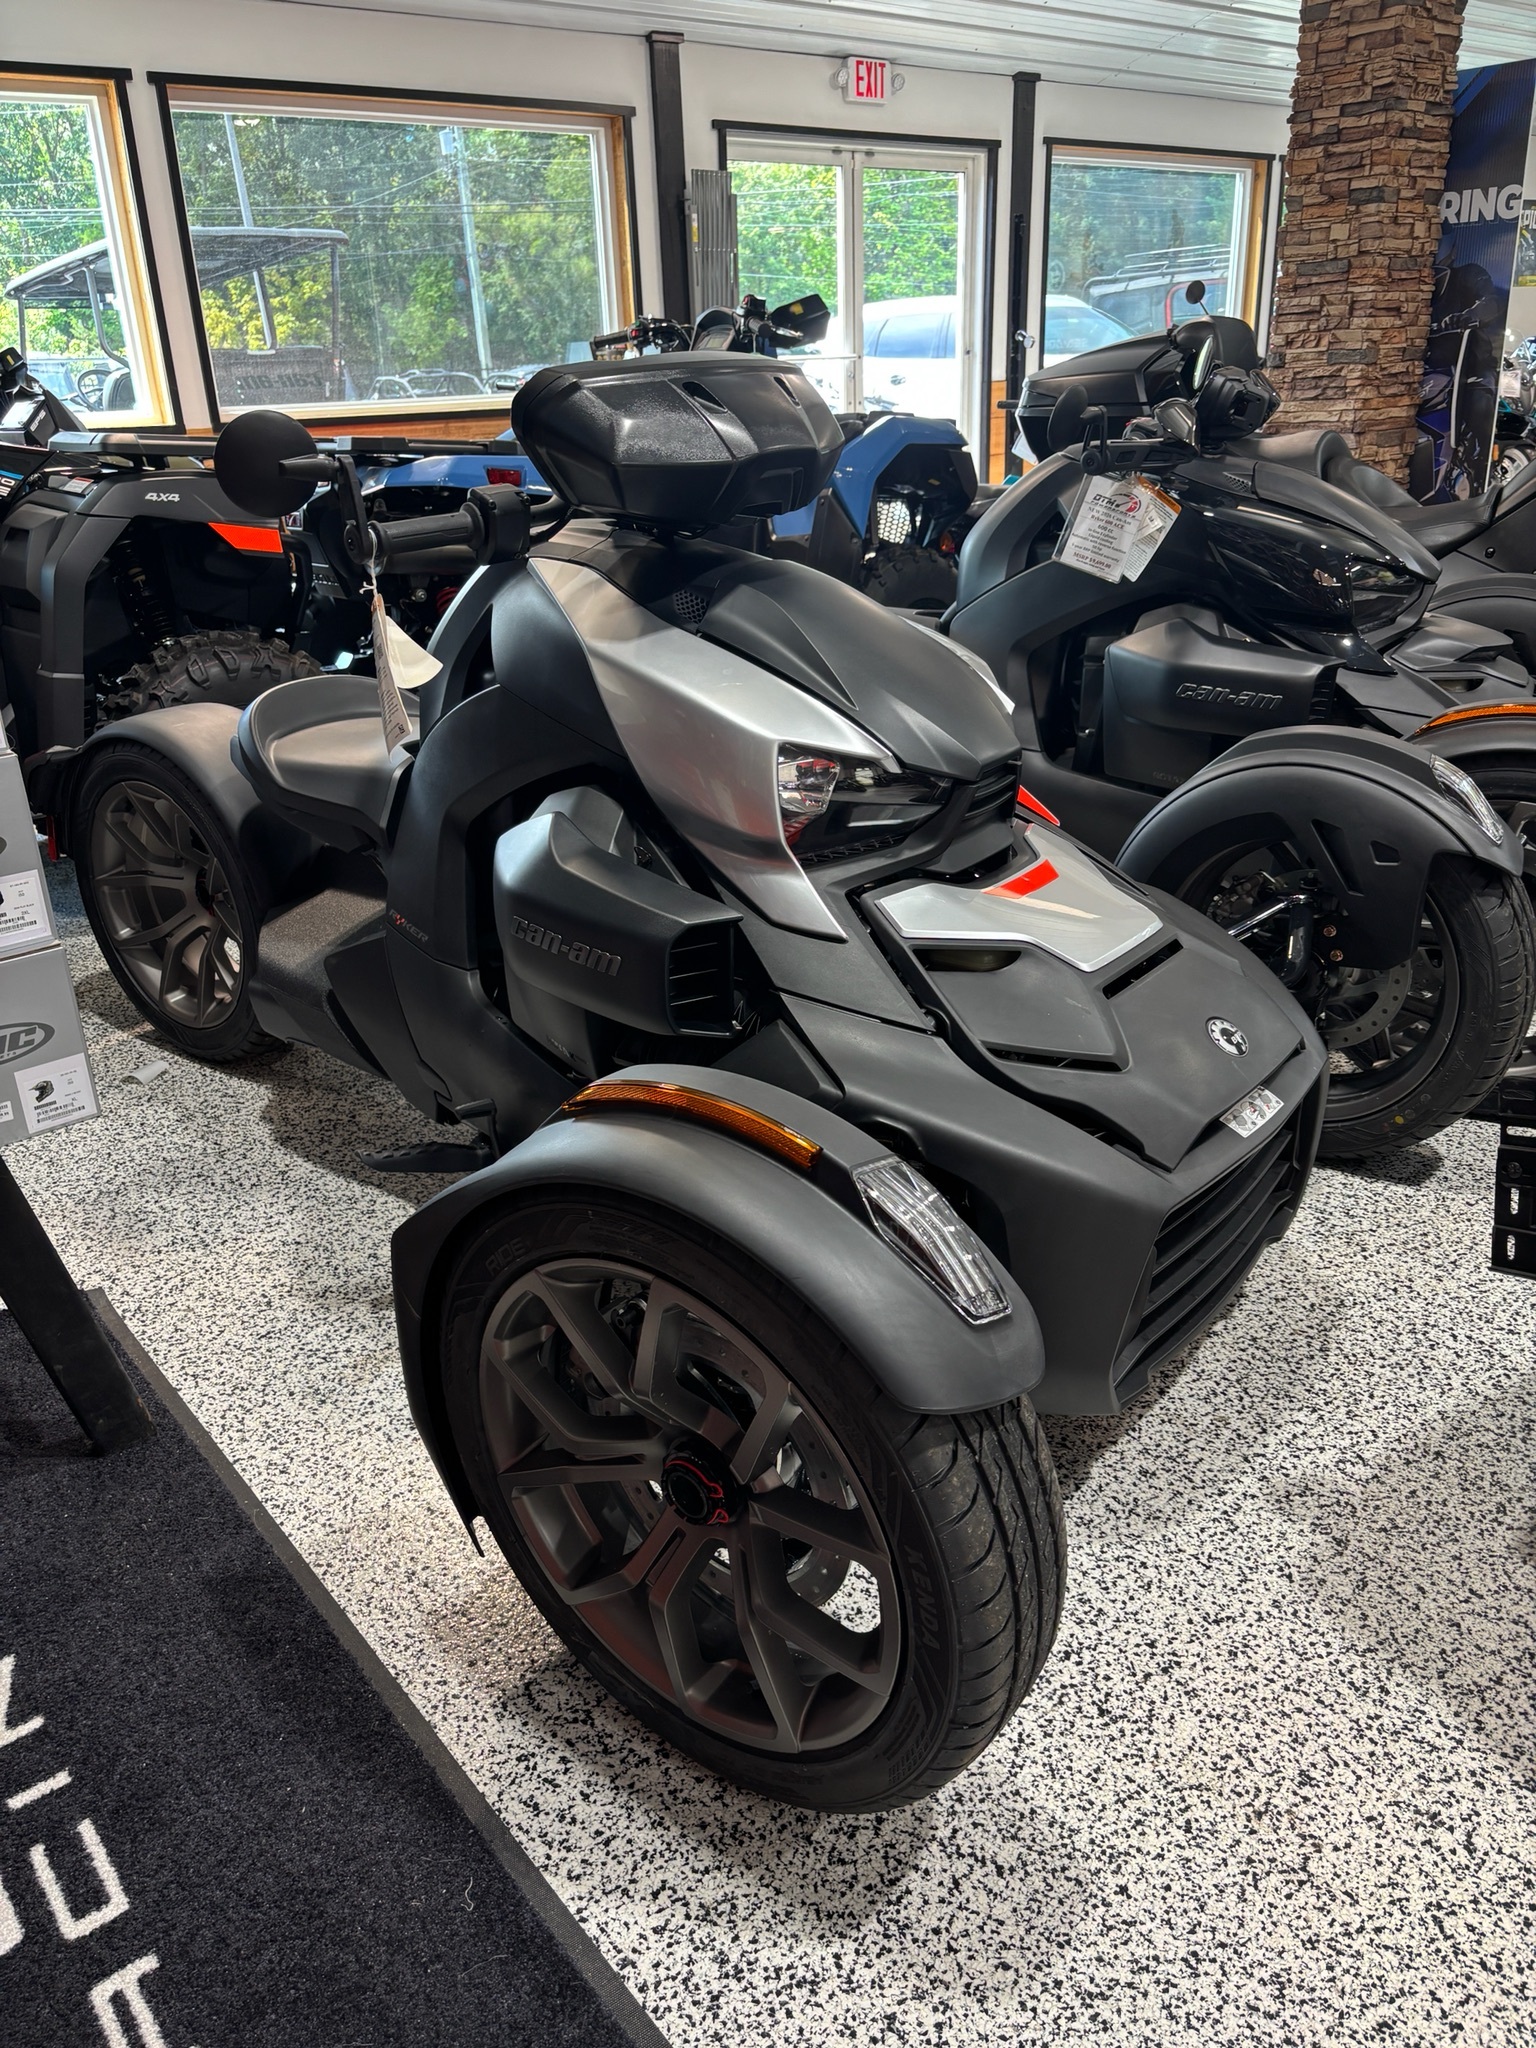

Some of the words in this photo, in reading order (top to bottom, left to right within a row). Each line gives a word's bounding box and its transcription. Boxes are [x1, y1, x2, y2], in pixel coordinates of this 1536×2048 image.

[855, 60, 886, 98] EXIT
[1098, 524, 1108, 532] 600
[1073, 551, 1089, 561] MSRP
[1176, 683, 1283, 709] can-am
[389, 909, 429, 942] RYKER
[510, 915, 622, 976] can-am
[903, 1544, 941, 1650] KENDA
